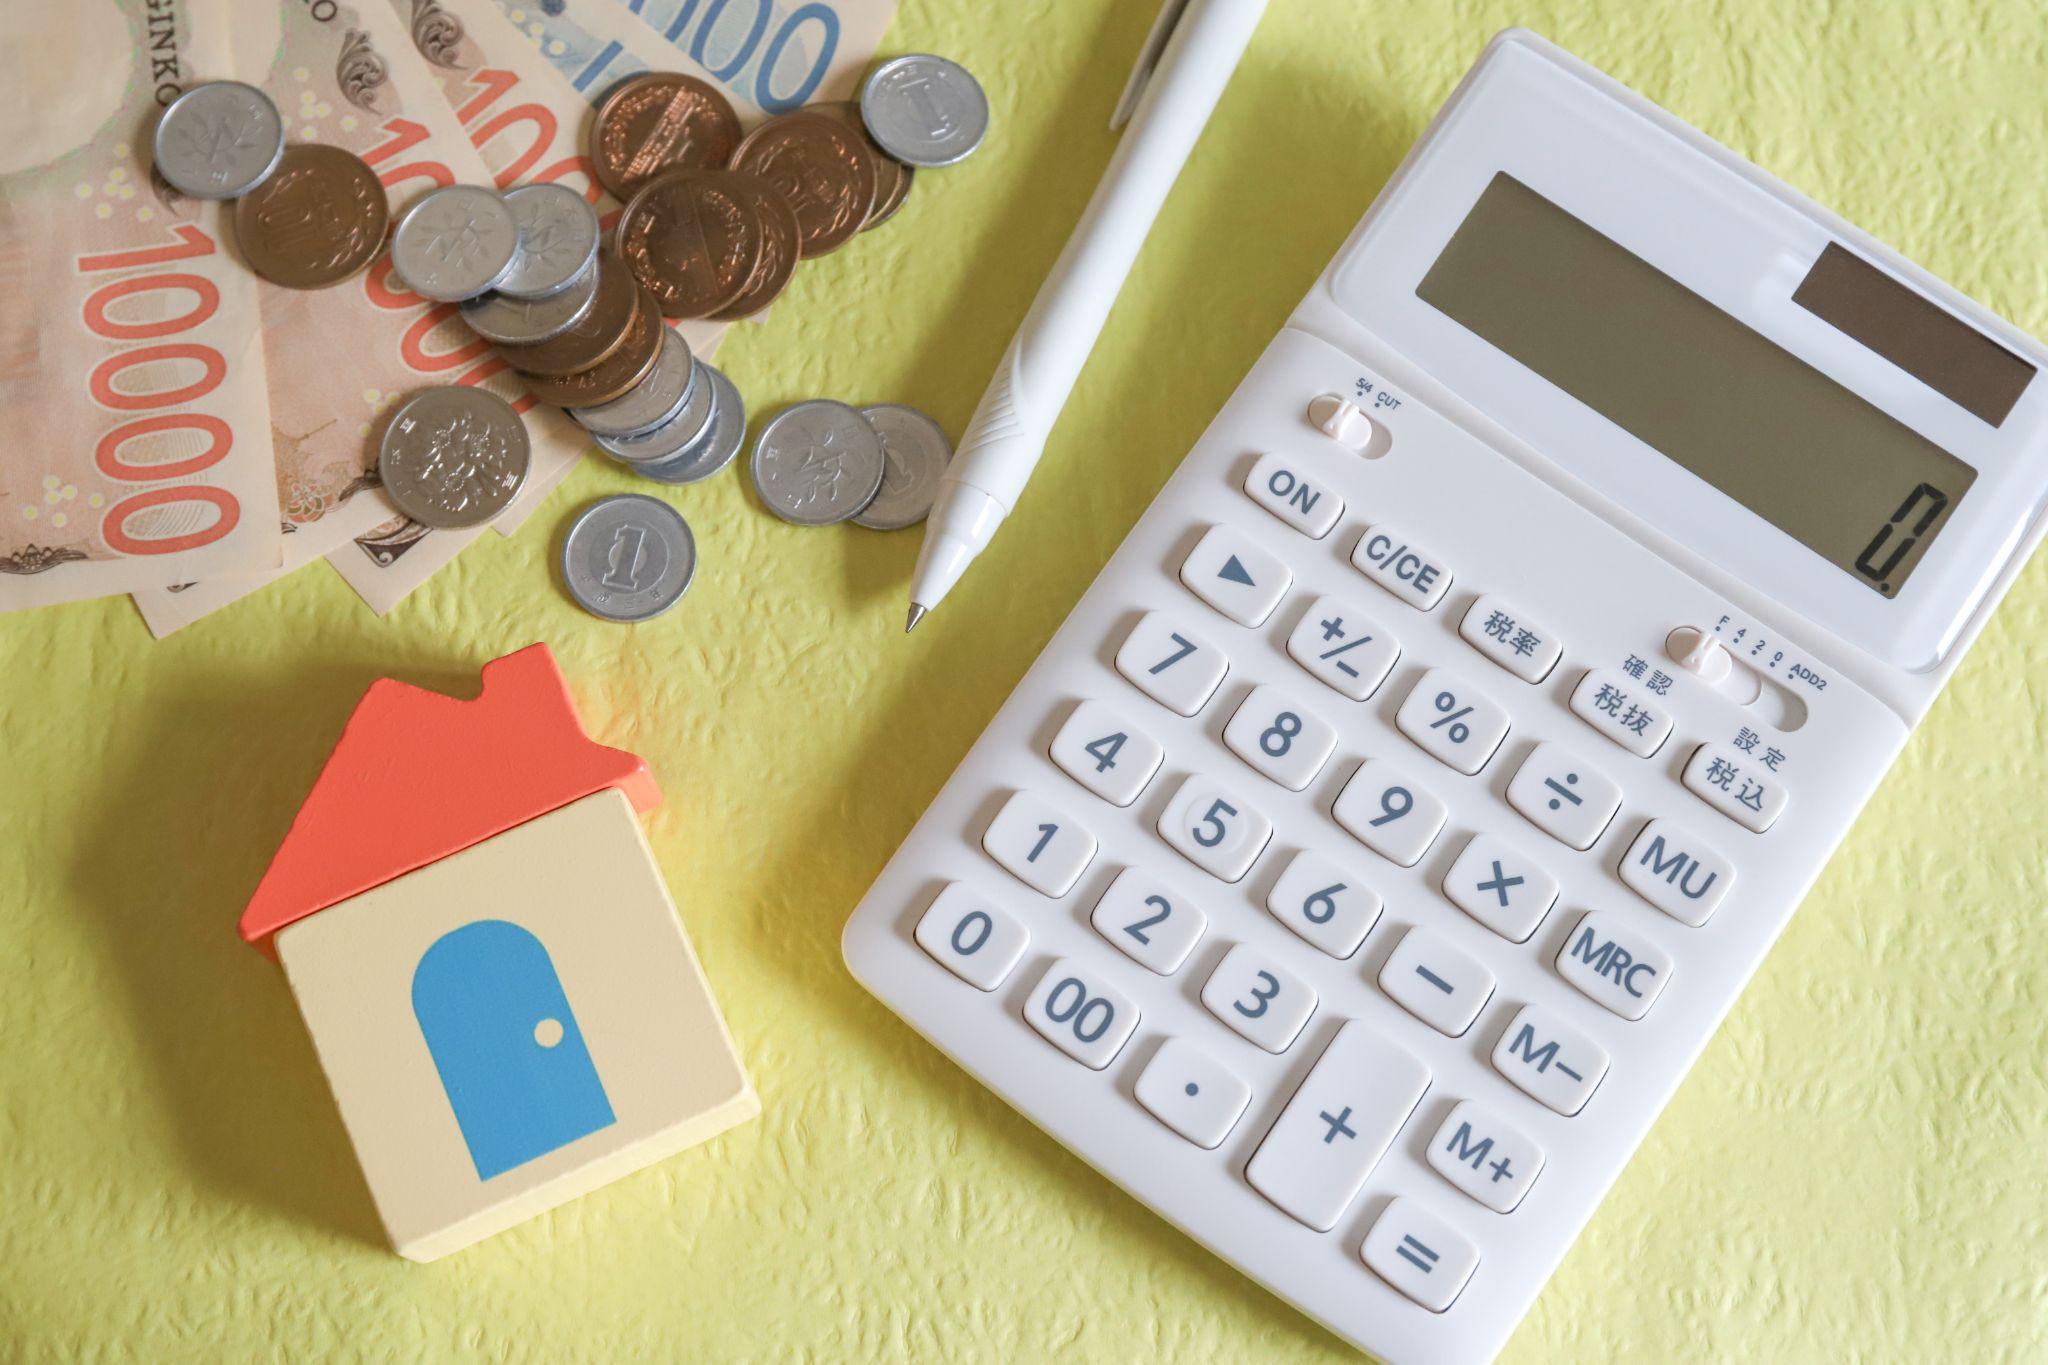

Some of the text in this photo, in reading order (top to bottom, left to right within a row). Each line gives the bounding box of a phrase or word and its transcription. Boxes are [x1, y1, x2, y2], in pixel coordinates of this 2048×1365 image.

[78, 224, 240, 555] 10000
[1355, 377, 1402, 410] 5/4 CUT
[1267, 469, 1322, 515] ON
[1366, 534, 1441, 594] C/CE
[1148, 632, 1199, 675] 7
[1484, 610, 1542, 657] 税率
[1719, 615, 1828, 691] F 4 2 0 ADD2
[1622, 653, 1675, 697] 確認
[1259, 711, 1303, 758] 8
[1429, 691, 1475, 744] %
[1594, 683, 1654, 737] 税抜
[1084, 731, 1129, 773] 4
[1732, 726, 1786, 773] 設定
[1368, 786, 1414, 828] 9
[1706, 757, 1764, 812] 税込
[1026, 823, 1059, 864] 1
[1192, 798, 1238, 848] 5
[1639, 835, 1718, 900] MU
[1122, 894, 1172, 946] 2
[1302, 882, 1348, 925] 6
[950, 910, 993, 956] 0
[1570, 926, 1657, 999] MRC
[1045, 977, 1115, 1044] 00
[1233, 969, 1281, 1019] 3
[1446, 1121, 1514, 1183] M+
